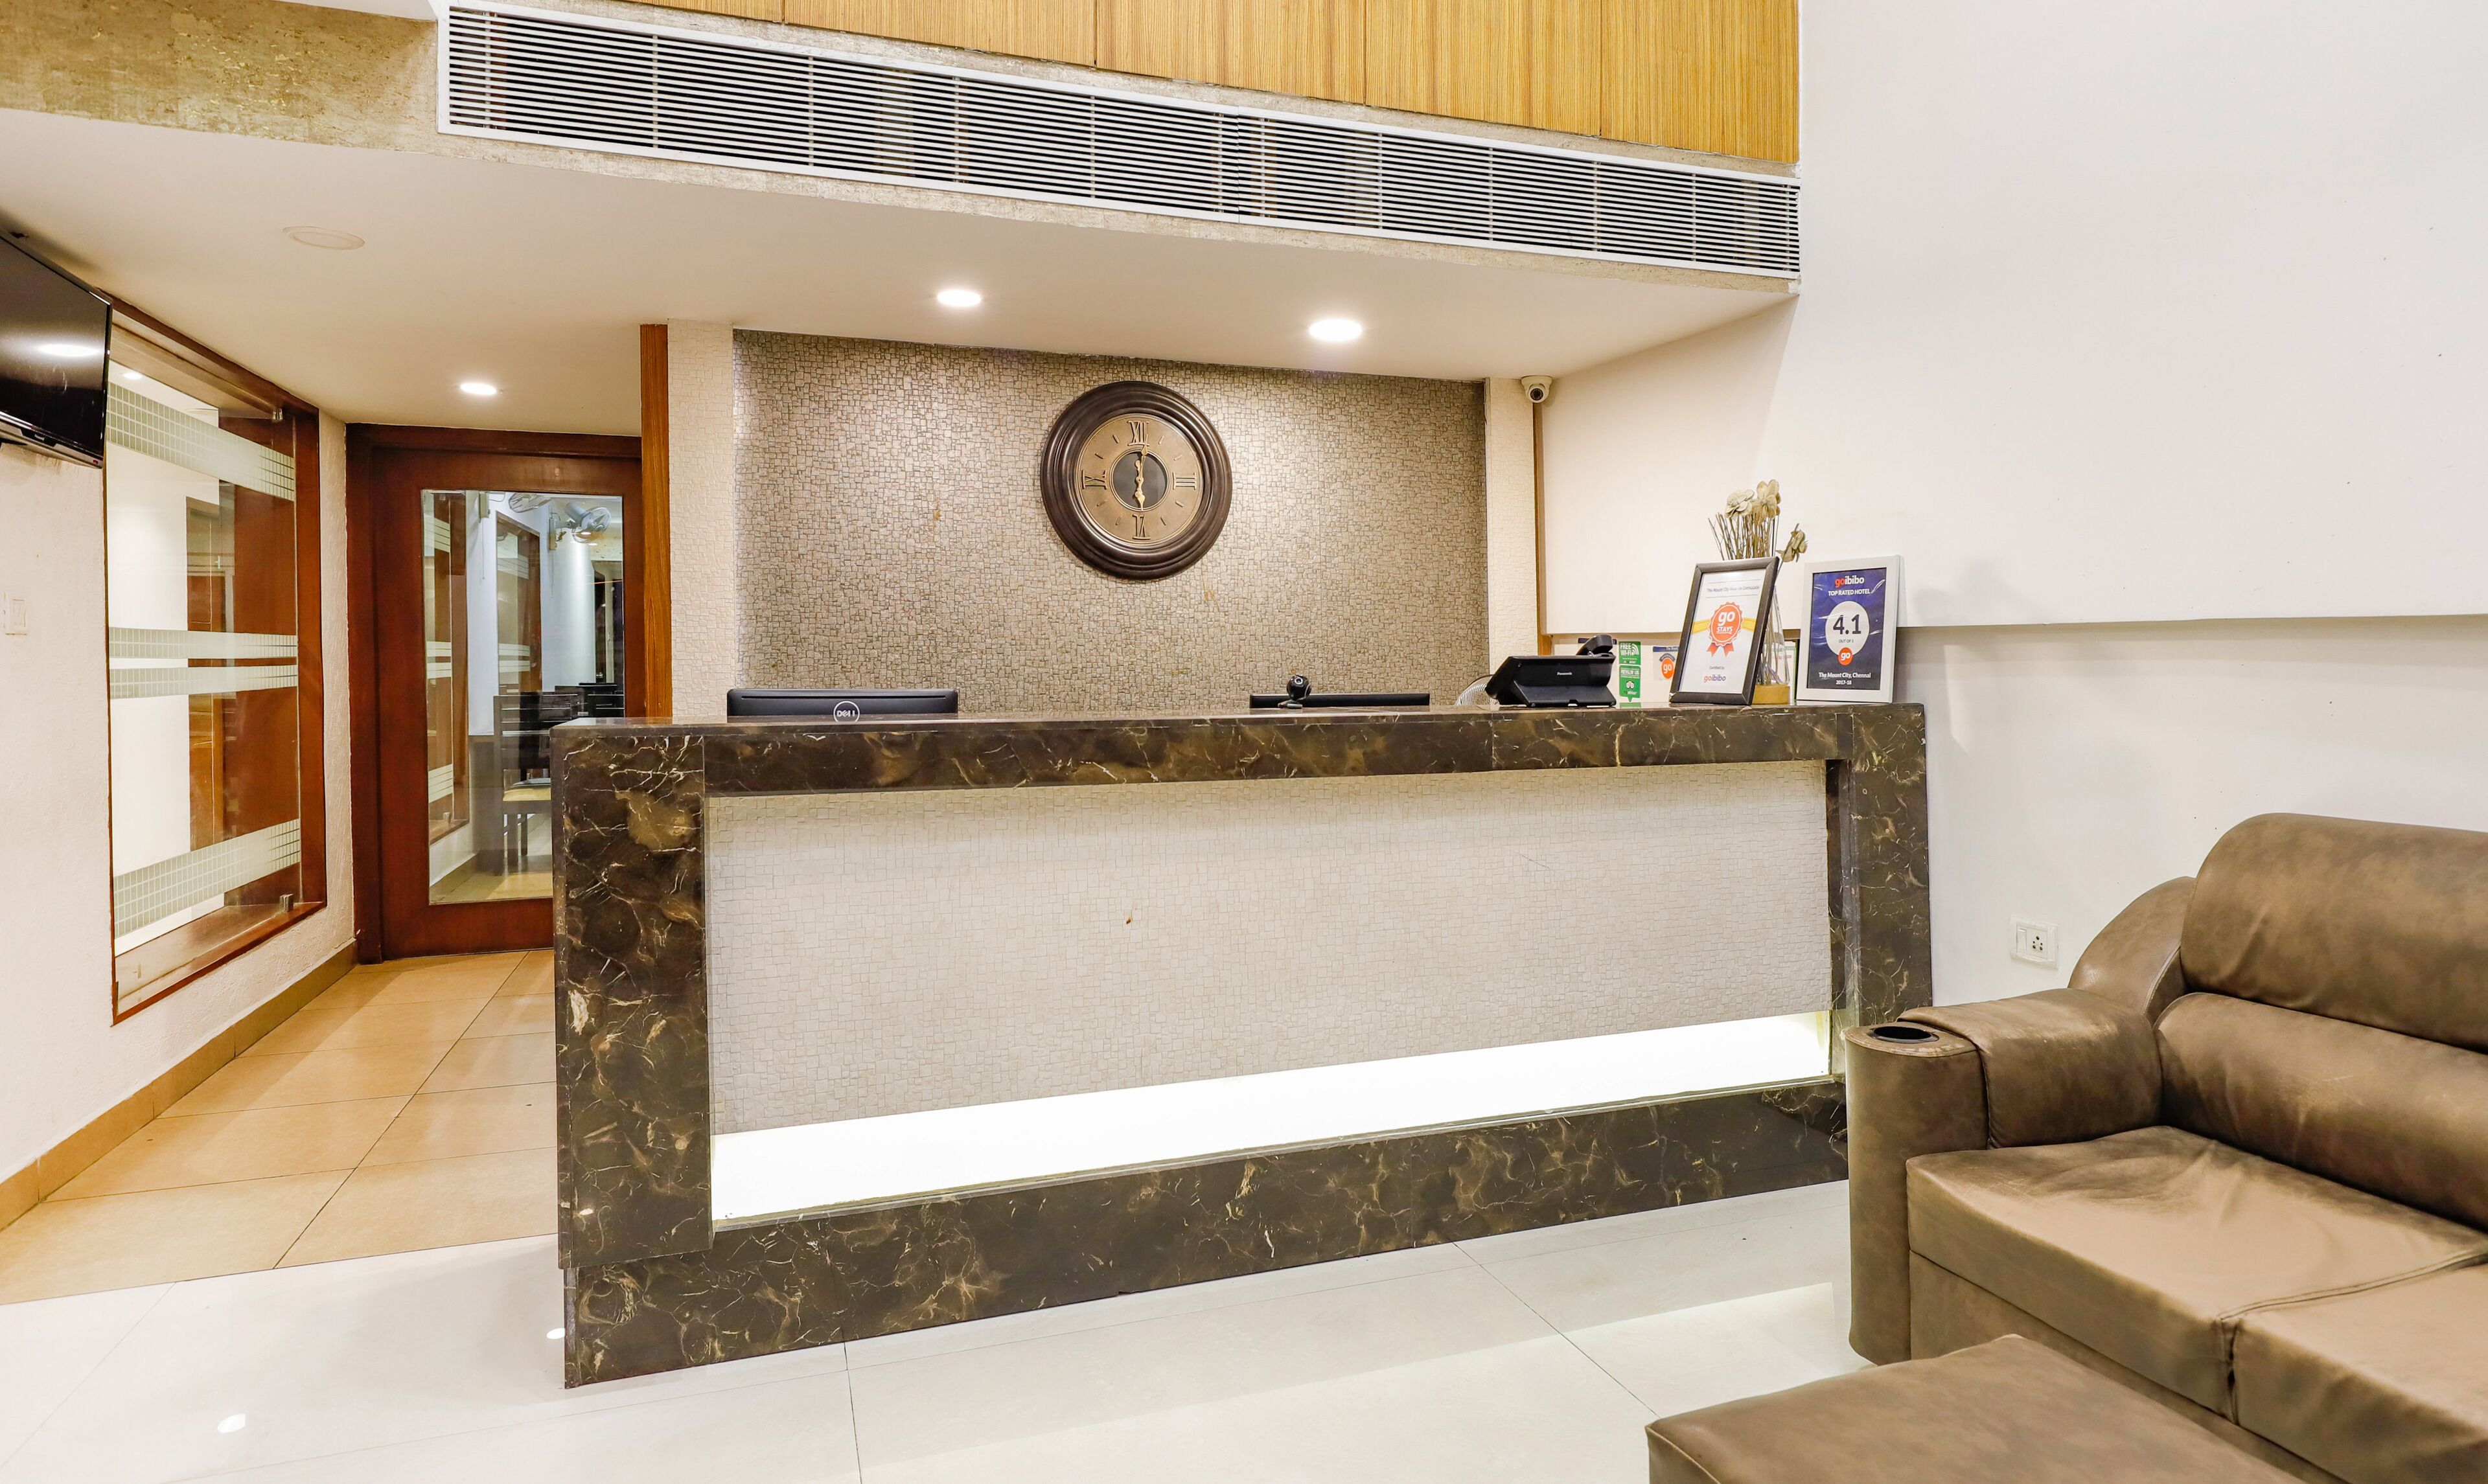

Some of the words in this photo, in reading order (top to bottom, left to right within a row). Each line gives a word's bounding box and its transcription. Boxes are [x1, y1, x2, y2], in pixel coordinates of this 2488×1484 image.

[1127, 420, 1150, 446] XII
[1173, 472, 1197, 490] III
[1835, 575, 1865, 588] goibibo
[1718, 611, 1736, 626] go
[1833, 614, 1861, 634] 4.1
[1841, 652, 1851, 661] go
[1663, 664, 1672, 674] go
[1703, 674, 1726, 683] goibibo
